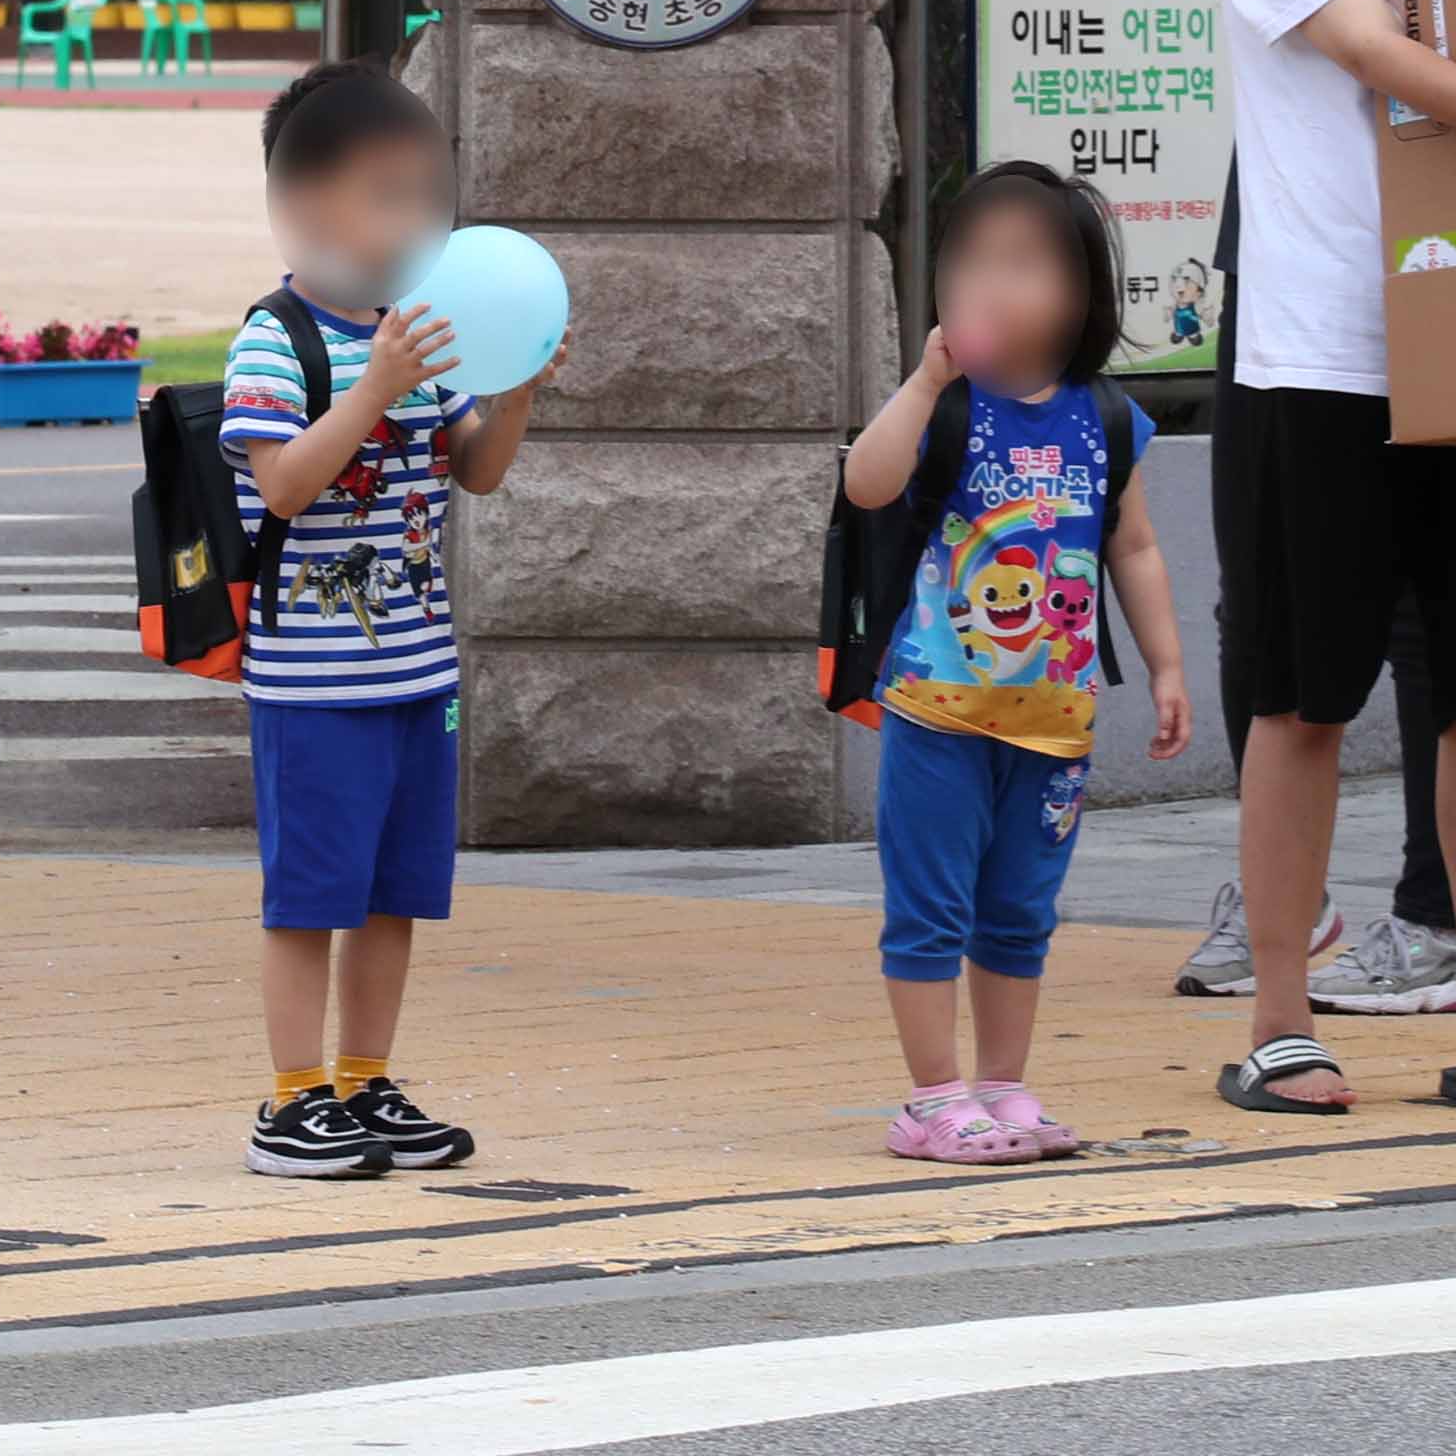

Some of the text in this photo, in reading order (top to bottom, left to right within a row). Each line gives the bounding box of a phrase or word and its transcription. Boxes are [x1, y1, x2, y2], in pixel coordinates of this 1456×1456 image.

[1012, 8, 1214, 55] 이내는 어린이
[1012, 66, 1214, 115] 식품안전보호구역
[1070, 128, 1159, 174] 입니다
[1126, 276, 1159, 304] 동구
[1008, 446, 1064, 477] 핑크퐁
[967, 461, 1094, 511] 상어가족
